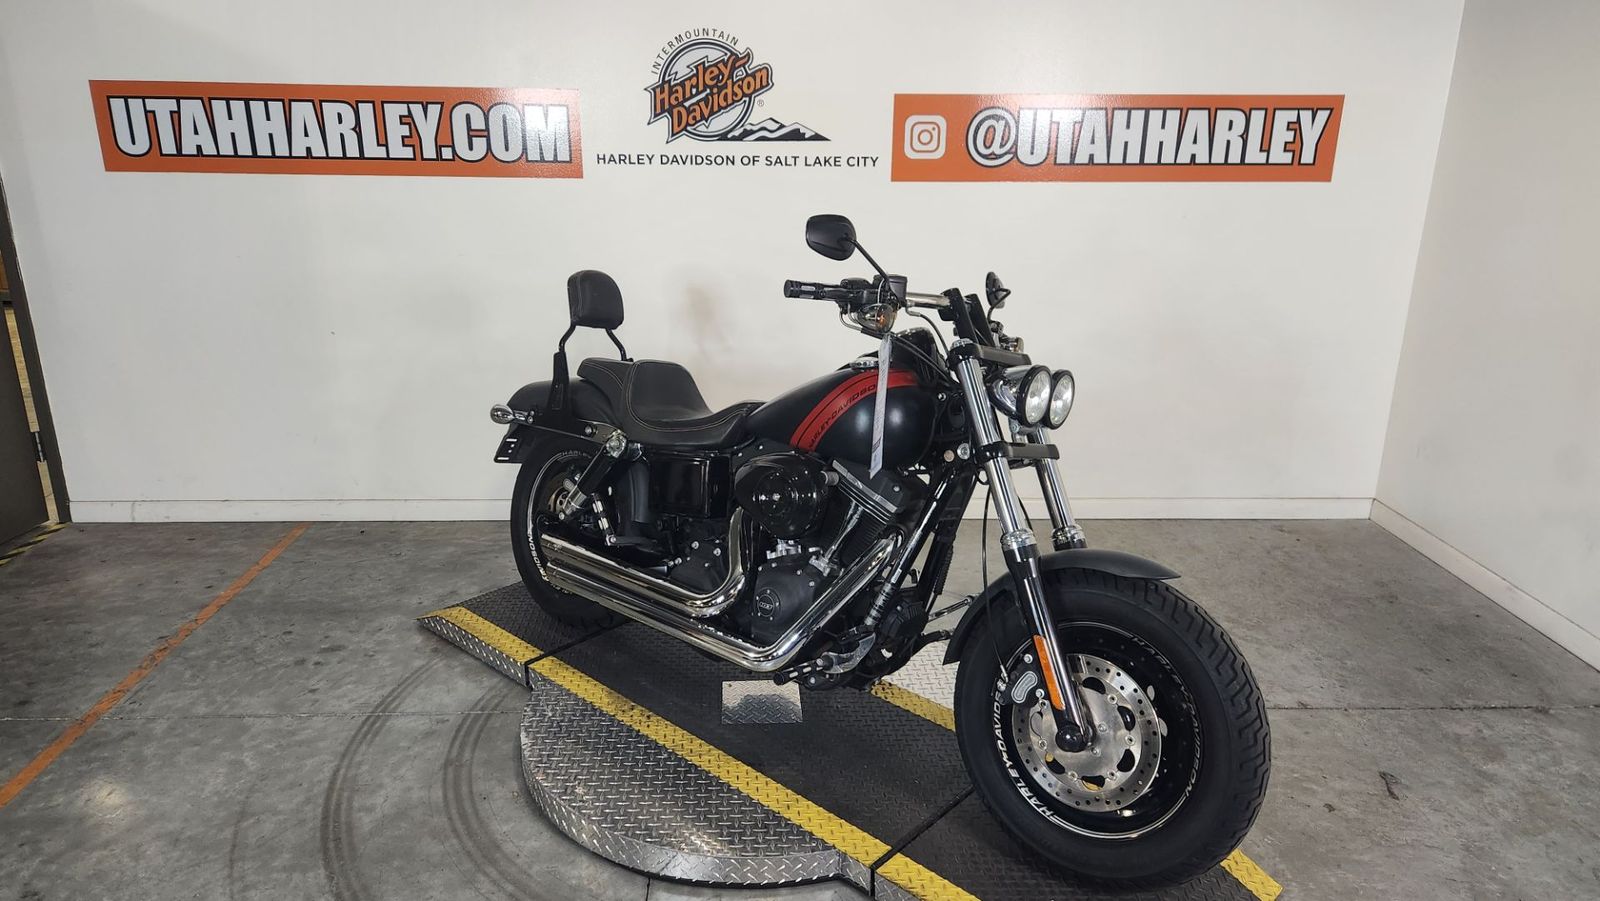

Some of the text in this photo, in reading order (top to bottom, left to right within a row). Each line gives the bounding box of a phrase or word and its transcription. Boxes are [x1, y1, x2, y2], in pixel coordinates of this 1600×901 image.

[651, 28, 739, 75] INTERMOUNTAIN
[106, 95, 573, 164] UTAHHARLEY.COM
[672, 67, 769, 134] Davidson
[596, 153, 879, 167] HARLEY DAVIDSON OF SALT LAKE CITY
[966, 106, 1334, 168] @UTAHHARLEY
